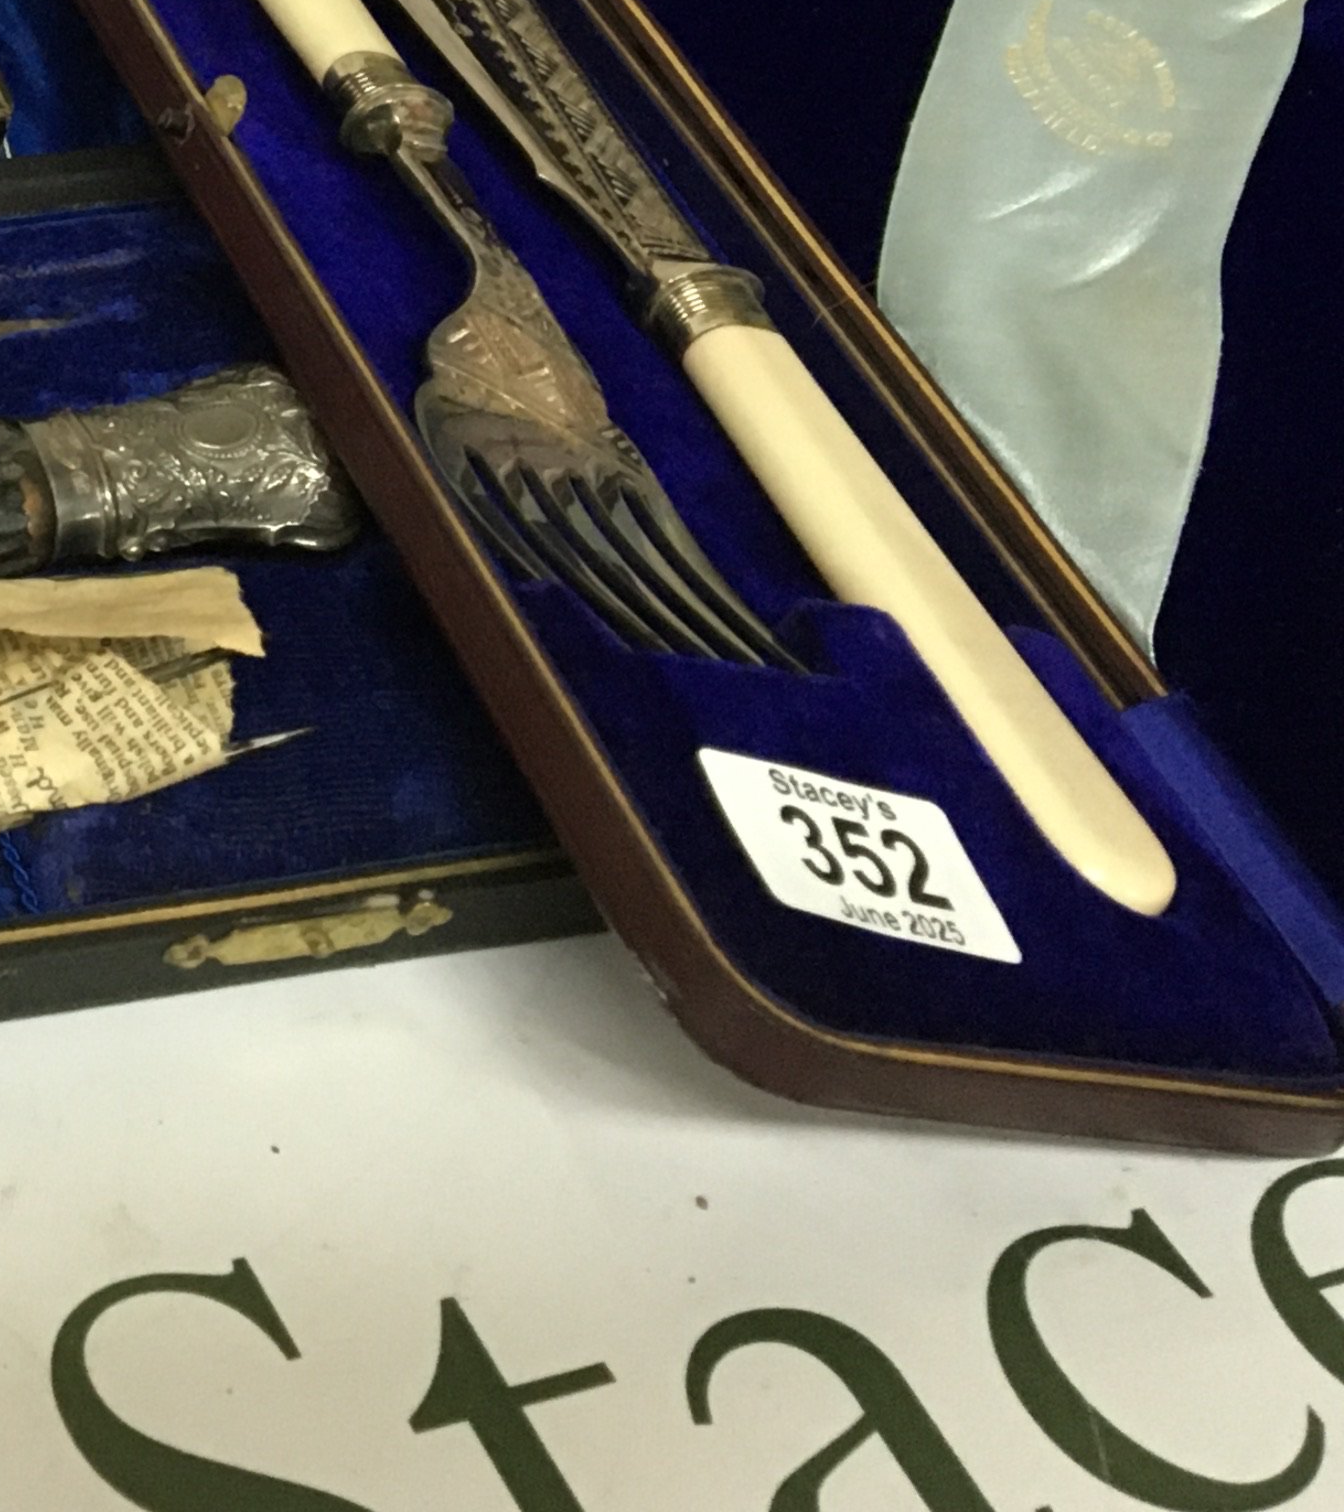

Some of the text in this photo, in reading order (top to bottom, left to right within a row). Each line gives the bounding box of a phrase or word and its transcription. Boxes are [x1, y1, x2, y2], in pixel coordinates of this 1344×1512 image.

[768, 768, 897, 821] Stacey's
[780, 805, 955, 910] 352
[840, 895, 966, 946] June 2025
